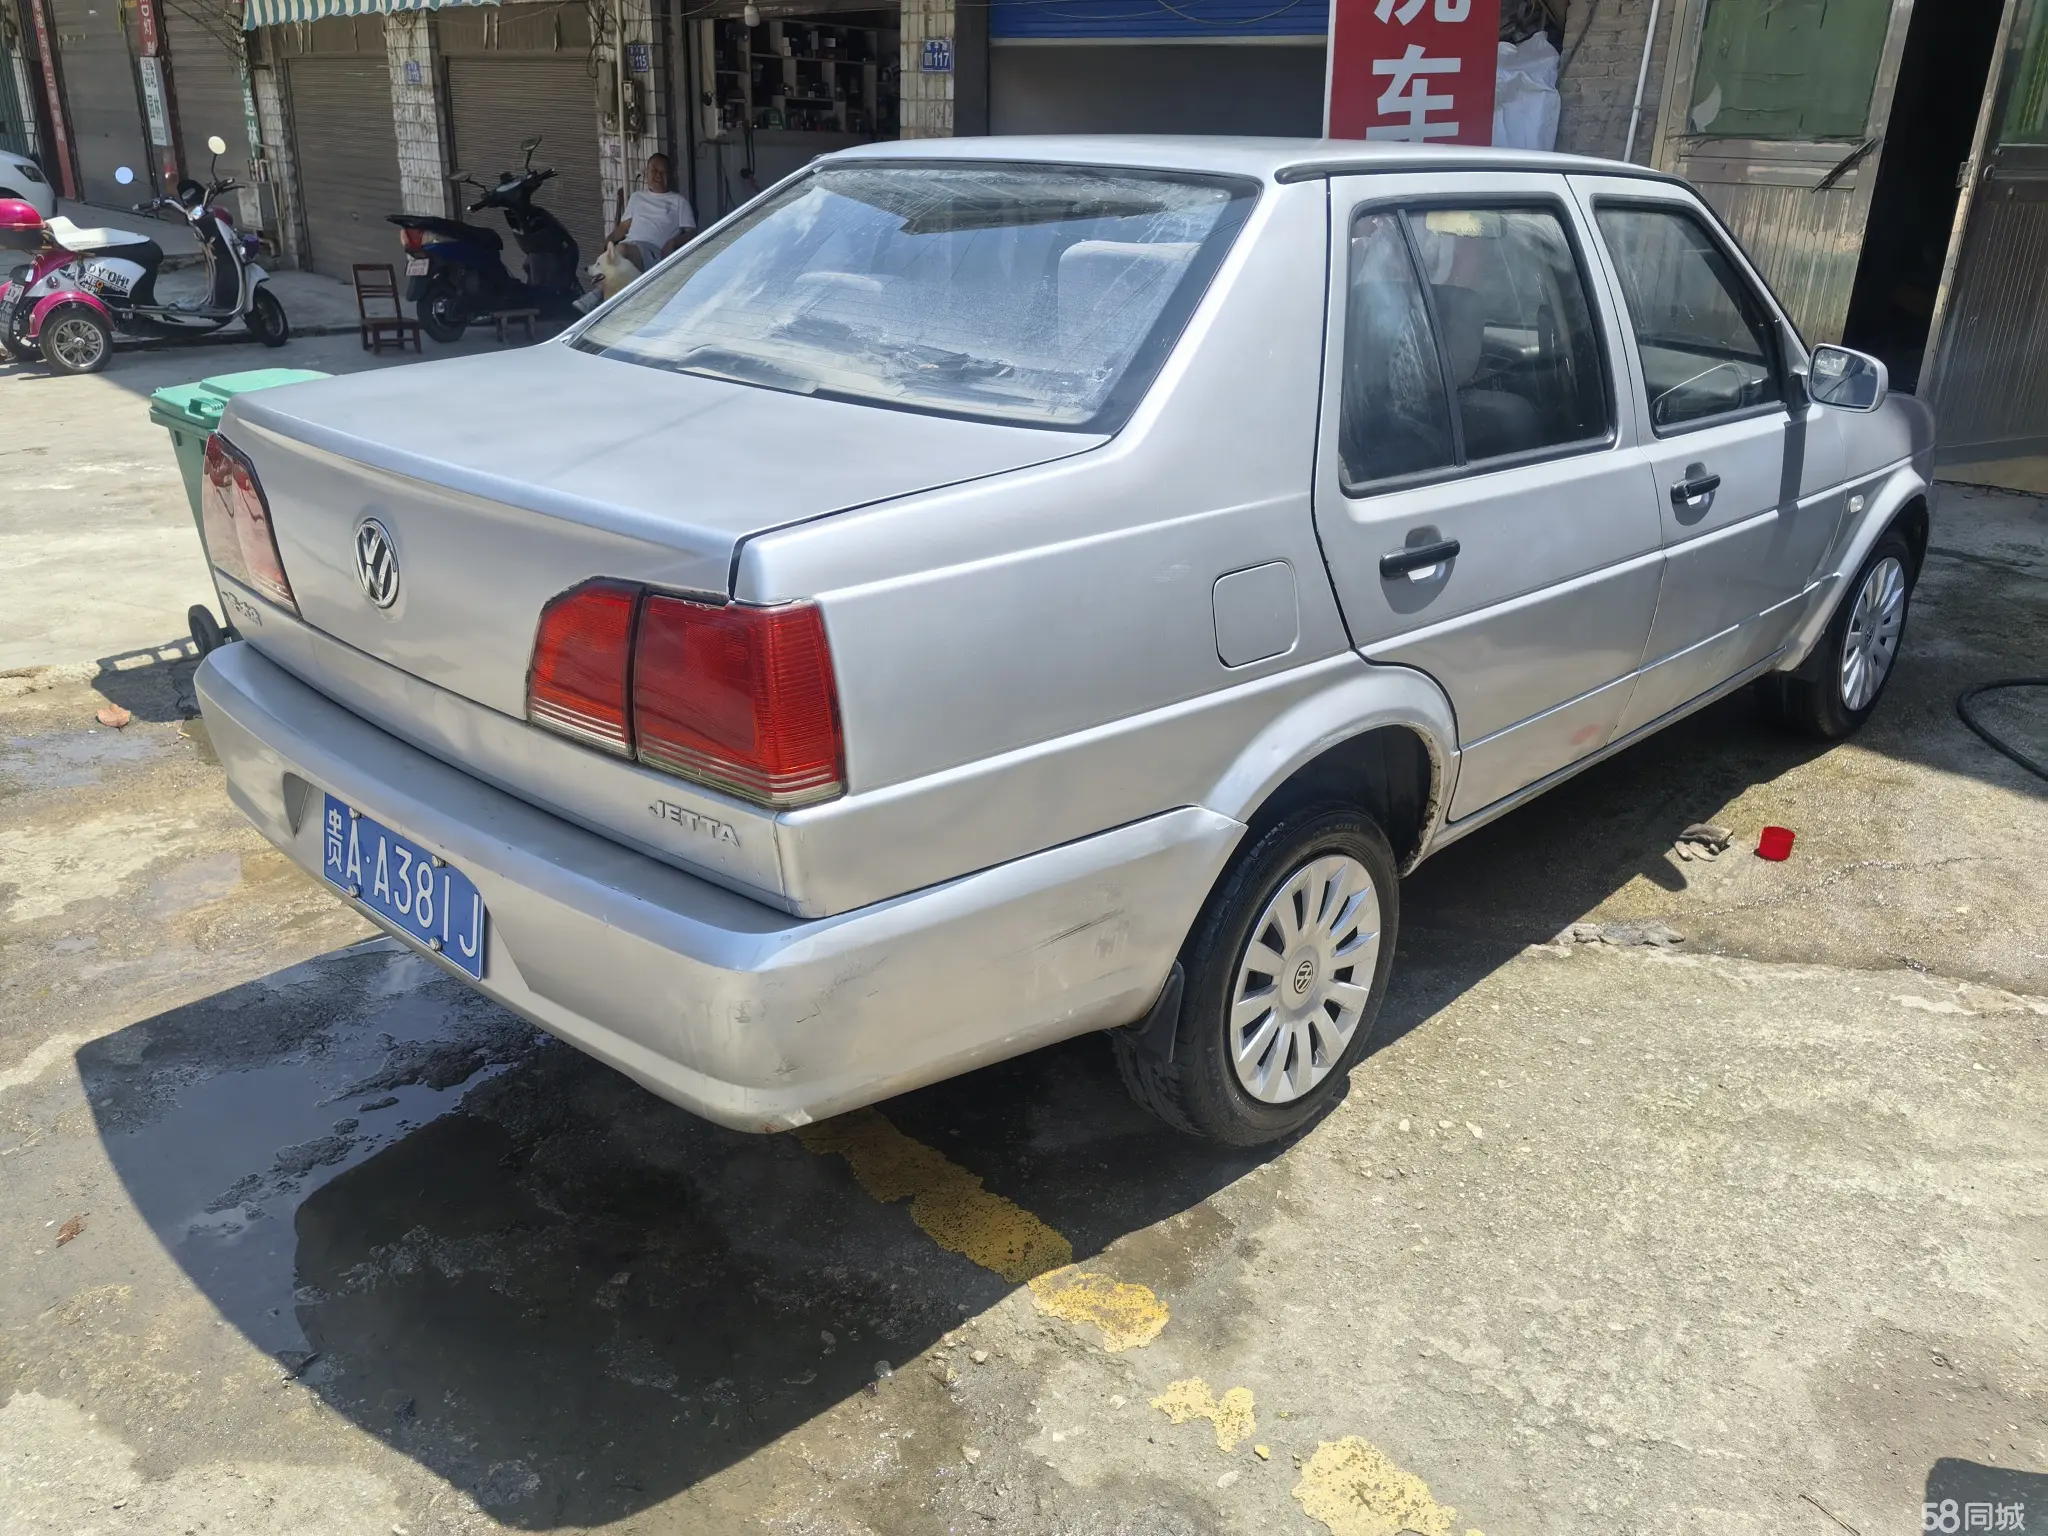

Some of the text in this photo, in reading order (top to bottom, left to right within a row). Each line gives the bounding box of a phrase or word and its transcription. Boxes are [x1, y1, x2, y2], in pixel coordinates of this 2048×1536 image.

[933, 52, 950, 67] 117
[1366, 0, 1471, 143] 车
[354, 516, 400, 609] VW
[648, 799, 741, 849] JETTA
